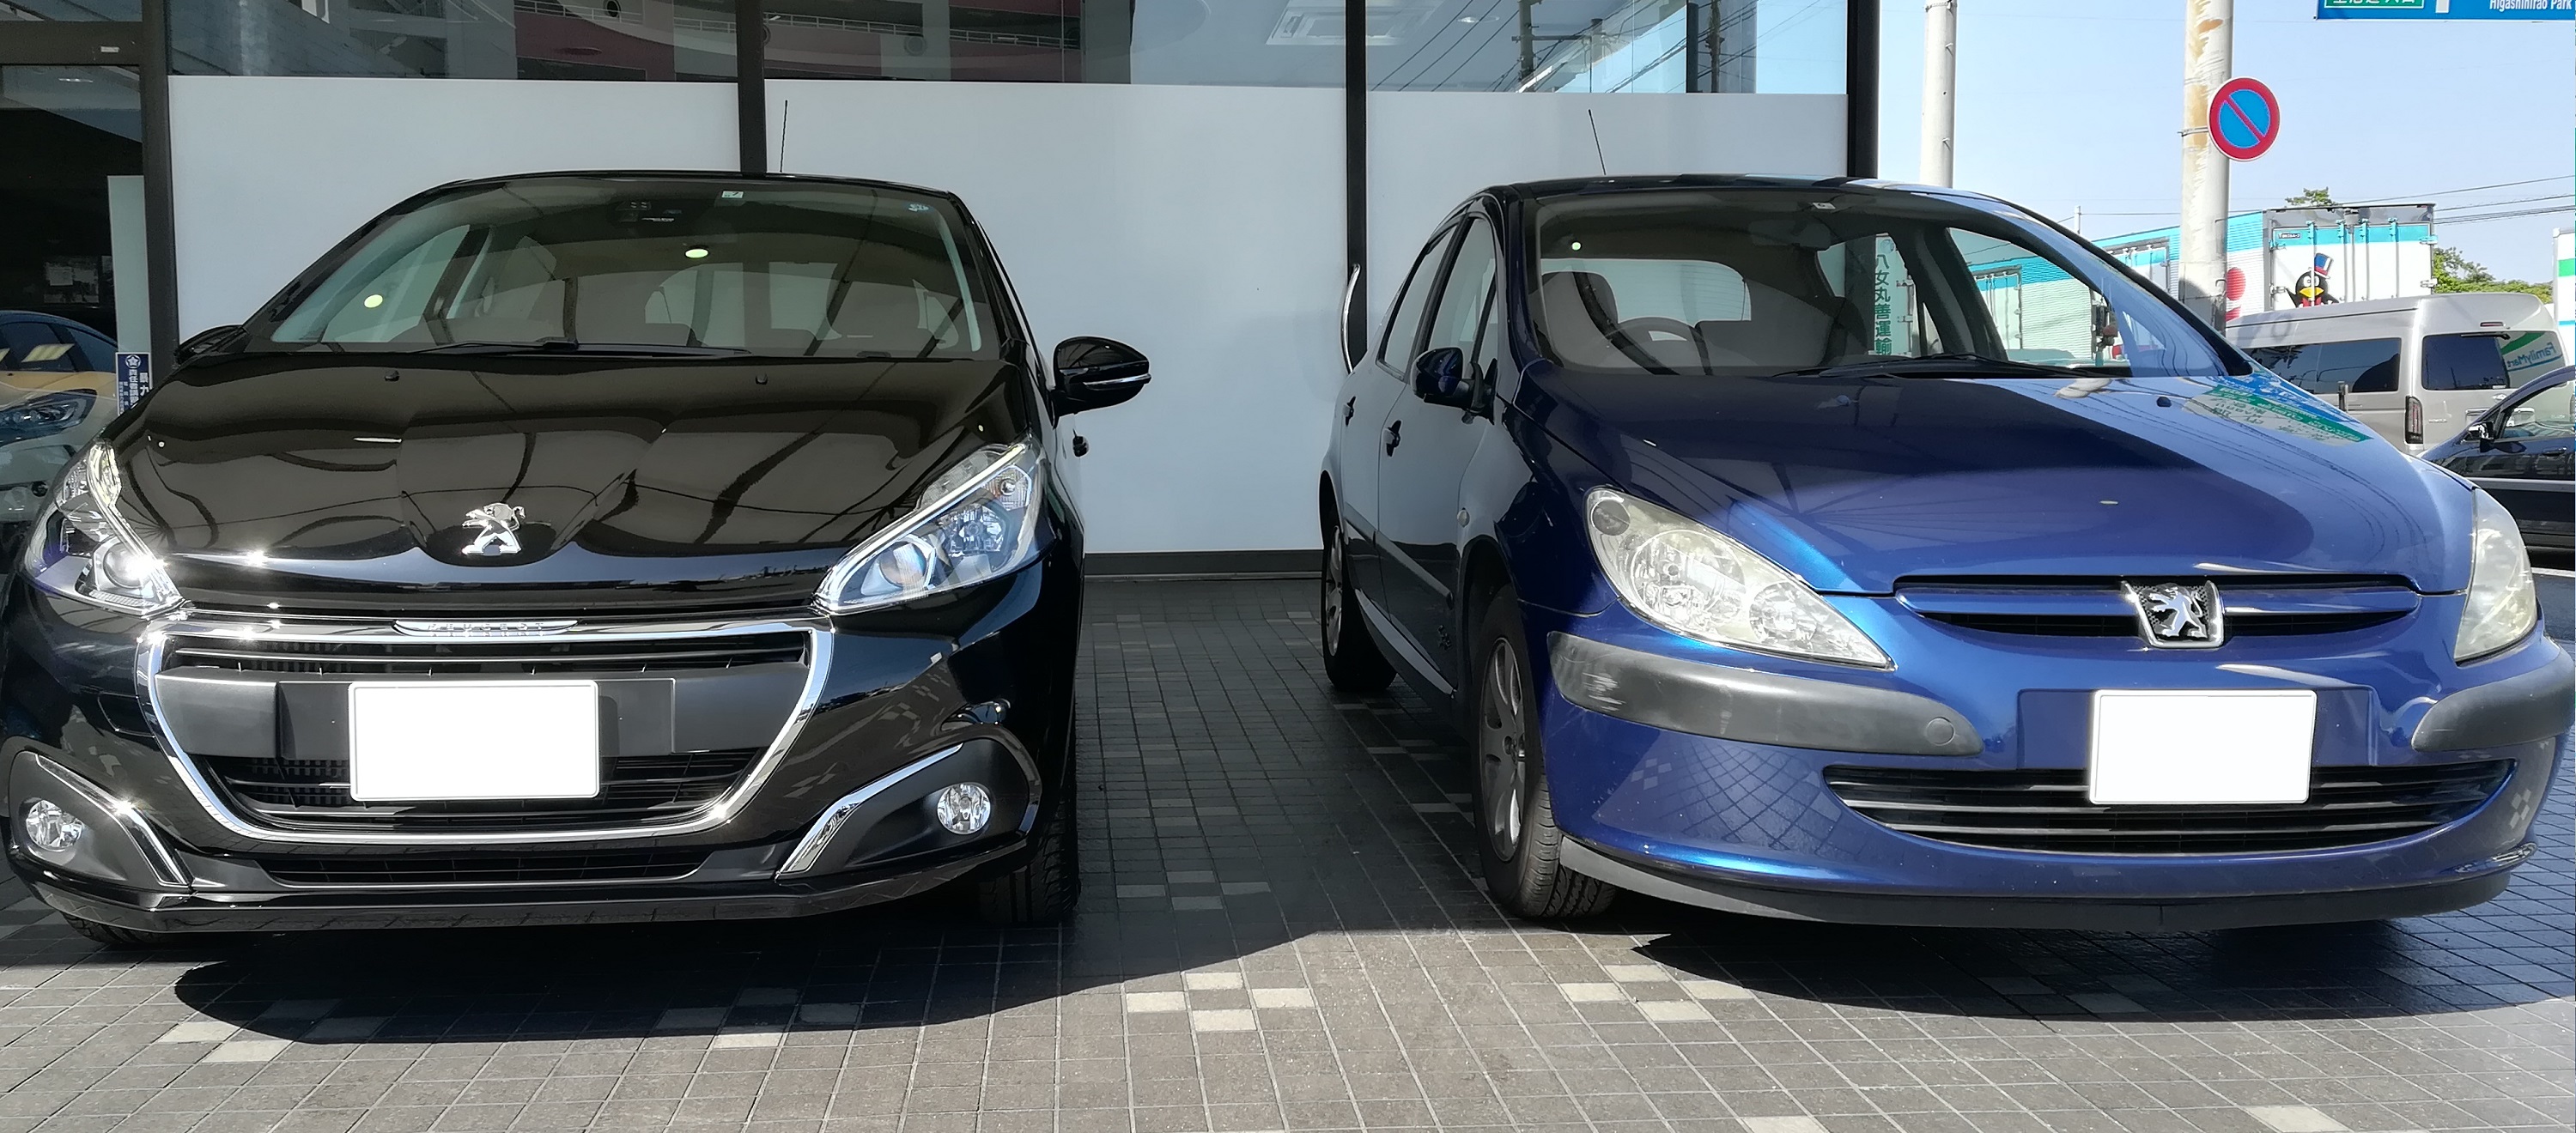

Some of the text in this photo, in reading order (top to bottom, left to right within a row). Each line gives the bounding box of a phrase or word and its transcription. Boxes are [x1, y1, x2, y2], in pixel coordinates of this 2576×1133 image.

[2550, 0, 2573, 10] Park
[1874, 254, 1893, 355] 八女丸善運輸
